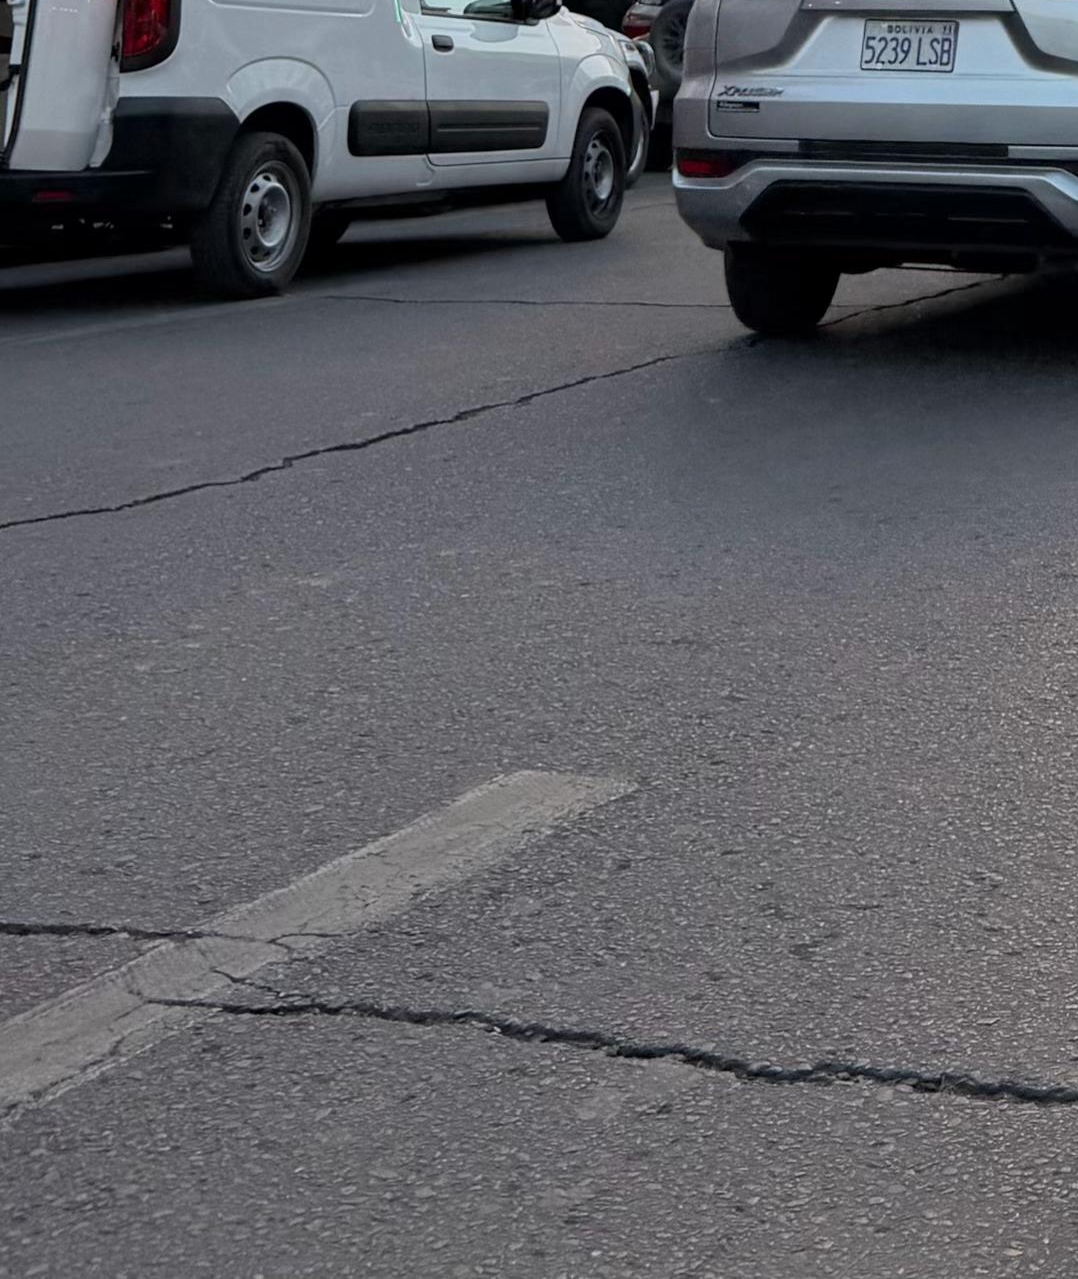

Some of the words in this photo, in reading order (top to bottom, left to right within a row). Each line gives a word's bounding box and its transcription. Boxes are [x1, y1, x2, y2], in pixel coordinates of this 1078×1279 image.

[888, 25, 934, 34] BOLIVIA
[864, 35, 912, 65] 5239
[916, 36, 952, 66] LSB
